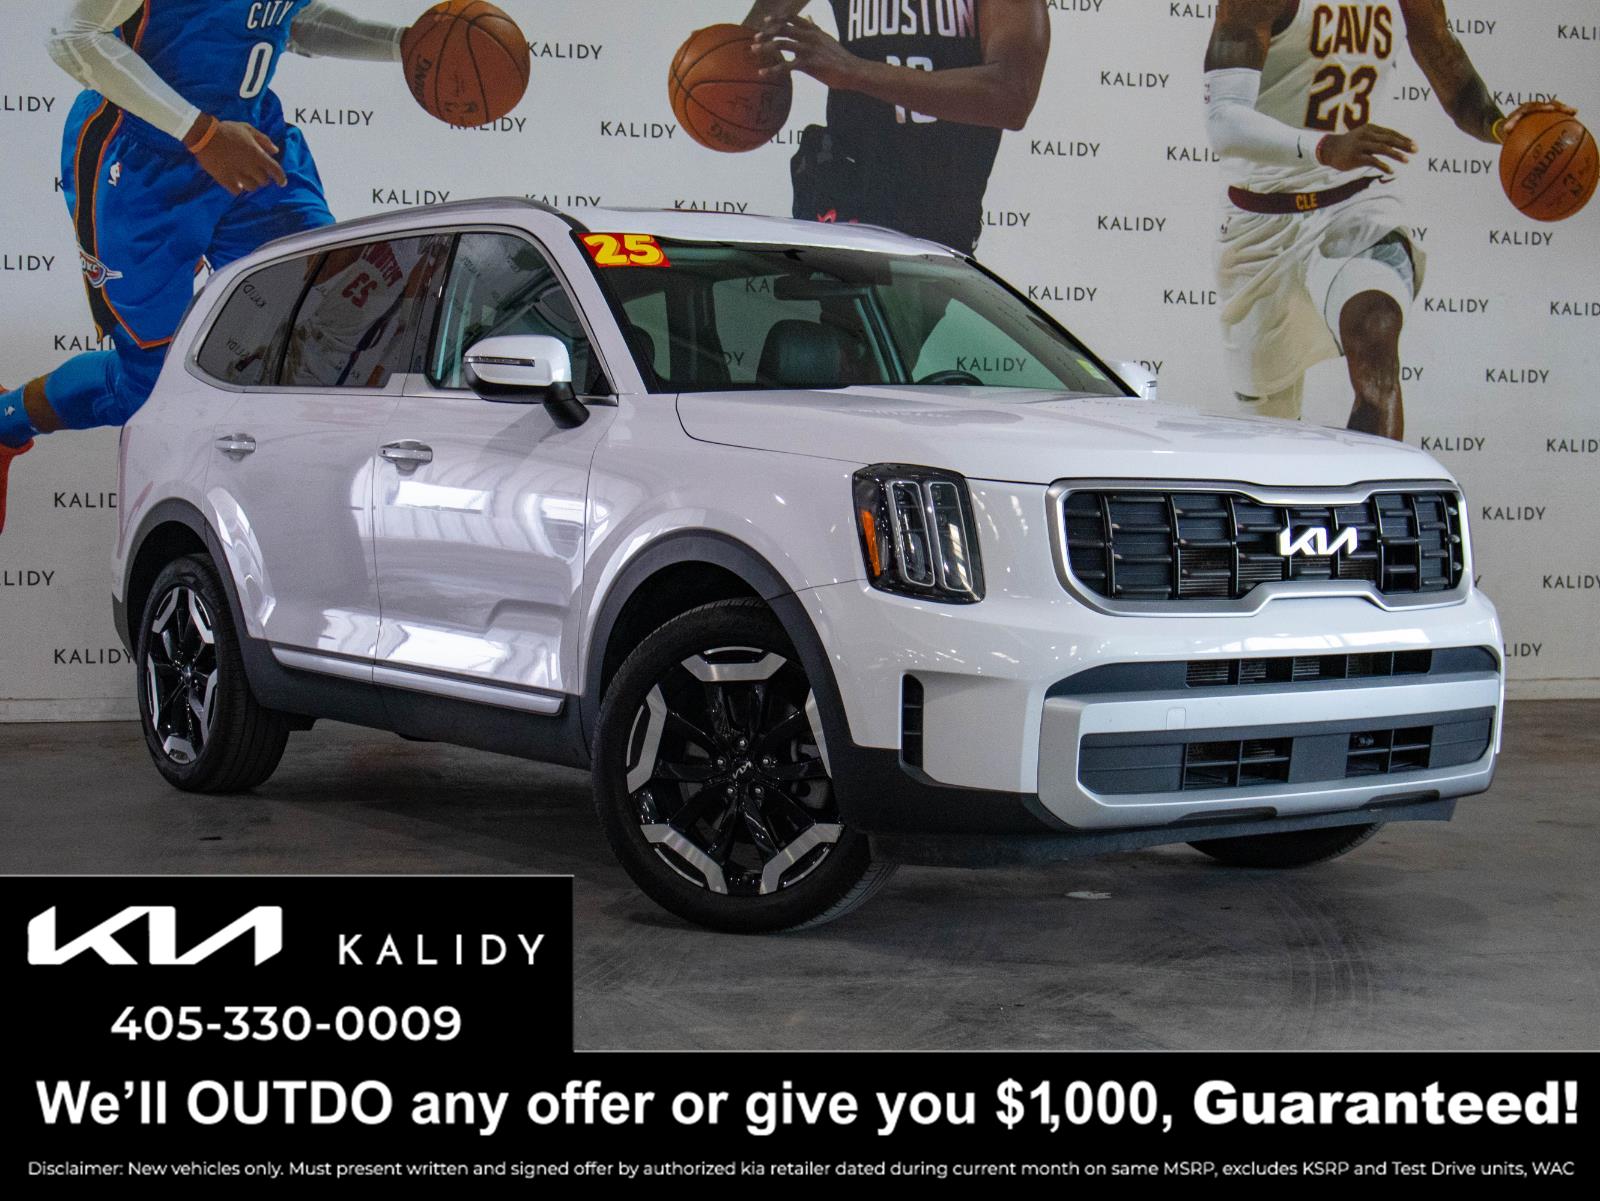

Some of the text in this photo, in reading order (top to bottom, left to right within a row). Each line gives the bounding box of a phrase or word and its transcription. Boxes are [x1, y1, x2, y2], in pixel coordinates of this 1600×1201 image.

[246, 0, 294, 29] CITY
[1169, 2, 1217, 18] KALI
[1309, 4, 1392, 60] CAVS
[527, 41, 603, 60] KALIDY
[239, 41, 274, 99] 0
[1100, 70, 1170, 88] KALIDY
[1304, 63, 1379, 132] 23
[1393, 86, 1431, 101] IDY
[0, 95, 55, 112] LIDY
[294, 107, 374, 126] KALIDY
[600, 120, 677, 139] KALIDY
[1030, 140, 1101, 157] KALIDY
[1428, 157, 1493, 174] KALIDY
[372, 188, 449, 205] KALIDY
[1295, 193, 1317, 210] CLE
[981, 211, 1031, 227] LIDY
[1097, 215, 1167, 233] KALIDY
[1489, 230, 1553, 246] KALIDY
[583, 233, 664, 266] 25
[0, 254, 55, 271] LIDY
[1028, 285, 1098, 302] KALIDY
[1424, 297, 1489, 313] KALIDY
[1550, 301, 1600, 317] KALID
[54, 334, 113, 351] KALI
[956, 355, 1027, 373] KALIDY
[1485, 368, 1550, 384] KALIDY
[1421, 436, 1486, 452] KALIDY
[1482, 506, 1546, 521] KALIDY
[0, 570, 55, 587] LIDY
